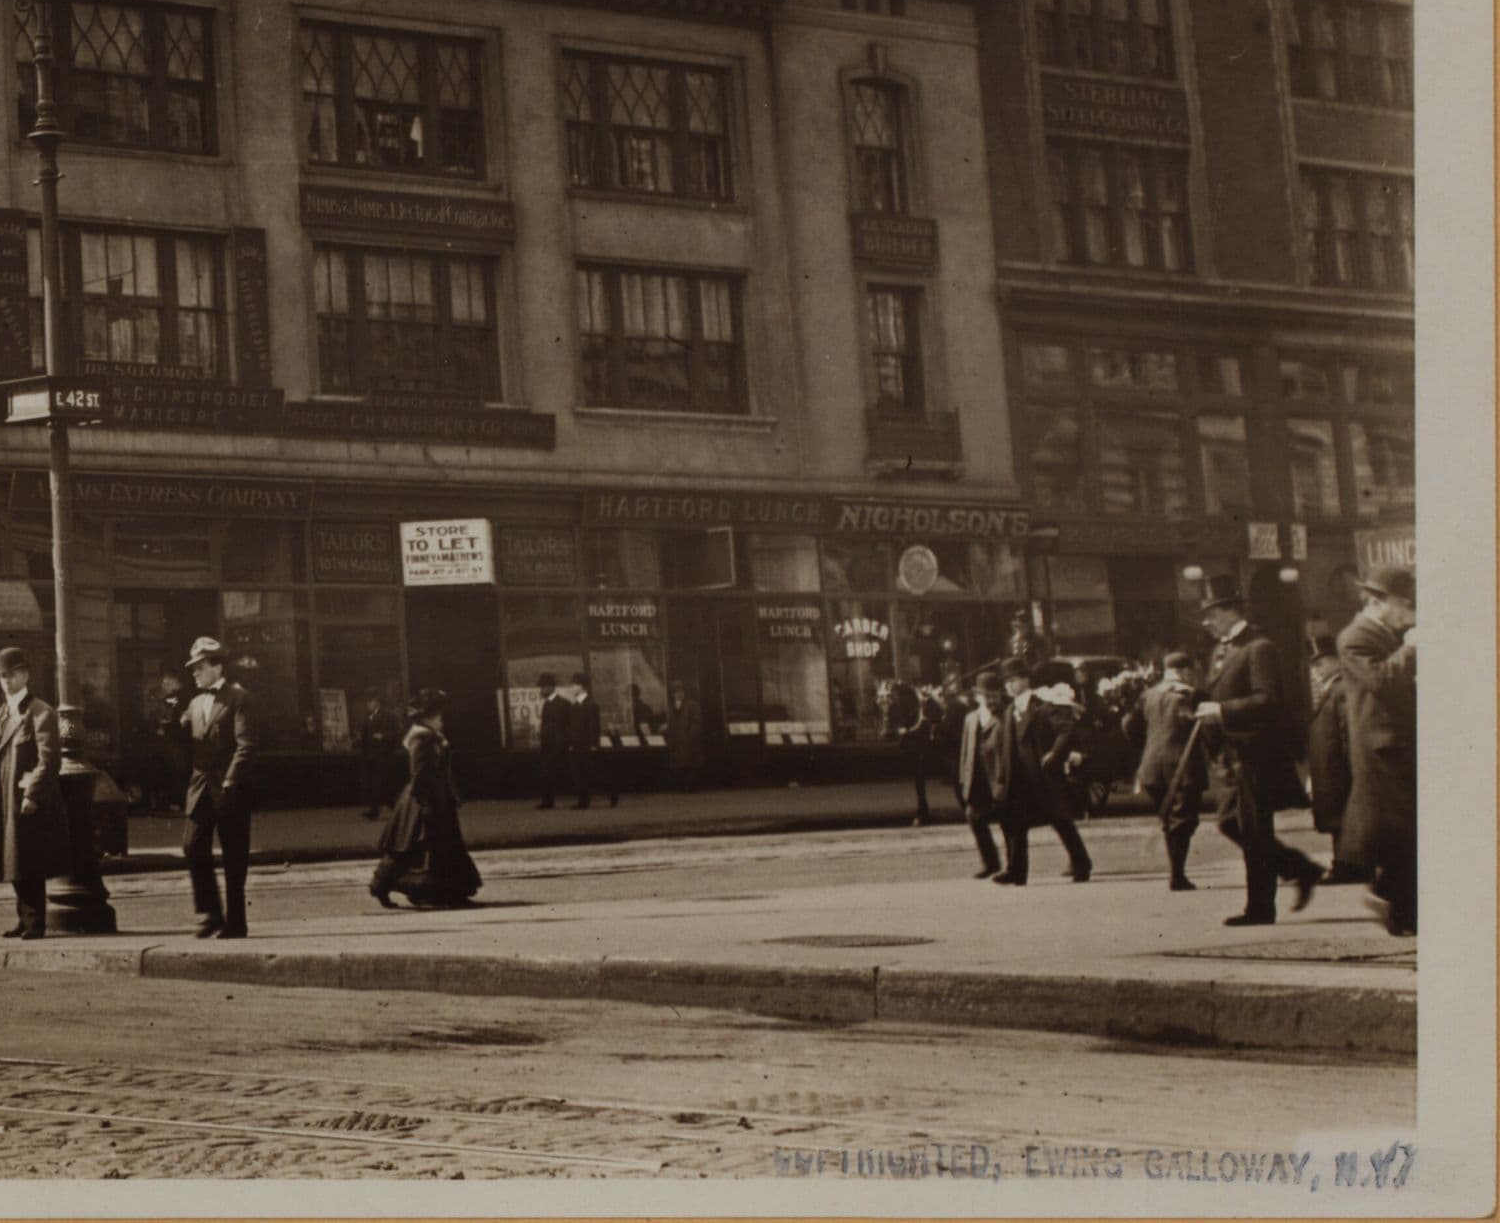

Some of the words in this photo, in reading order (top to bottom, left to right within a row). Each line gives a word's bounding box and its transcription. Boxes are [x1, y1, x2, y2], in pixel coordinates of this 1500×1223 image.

[114, 365, 199, 381] SOLOMON
[132, 385, 270, 405] CHIROPODIST
[112, 408, 222, 423] MANICURE
[30, 481, 102, 501] AMS
[109, 482, 201, 504] EXPRESS
[206, 483, 300, 508] COMPANY
[599, 496, 731, 522] HARTFORD
[742, 498, 822, 524] LUNCH
[836, 502, 1029, 535] NICHOLSON'S
[415, 525, 469, 537] STORE
[319, 531, 389, 552] TAILORS
[407, 538, 430, 553] TO
[438, 536, 479, 551] LET
[587, 602, 656, 620] HARTFORD
[757, 604, 820, 621] HARTFORD
[600, 621, 649, 638] LUNCH
[769, 623, 812, 639] LUNCH
